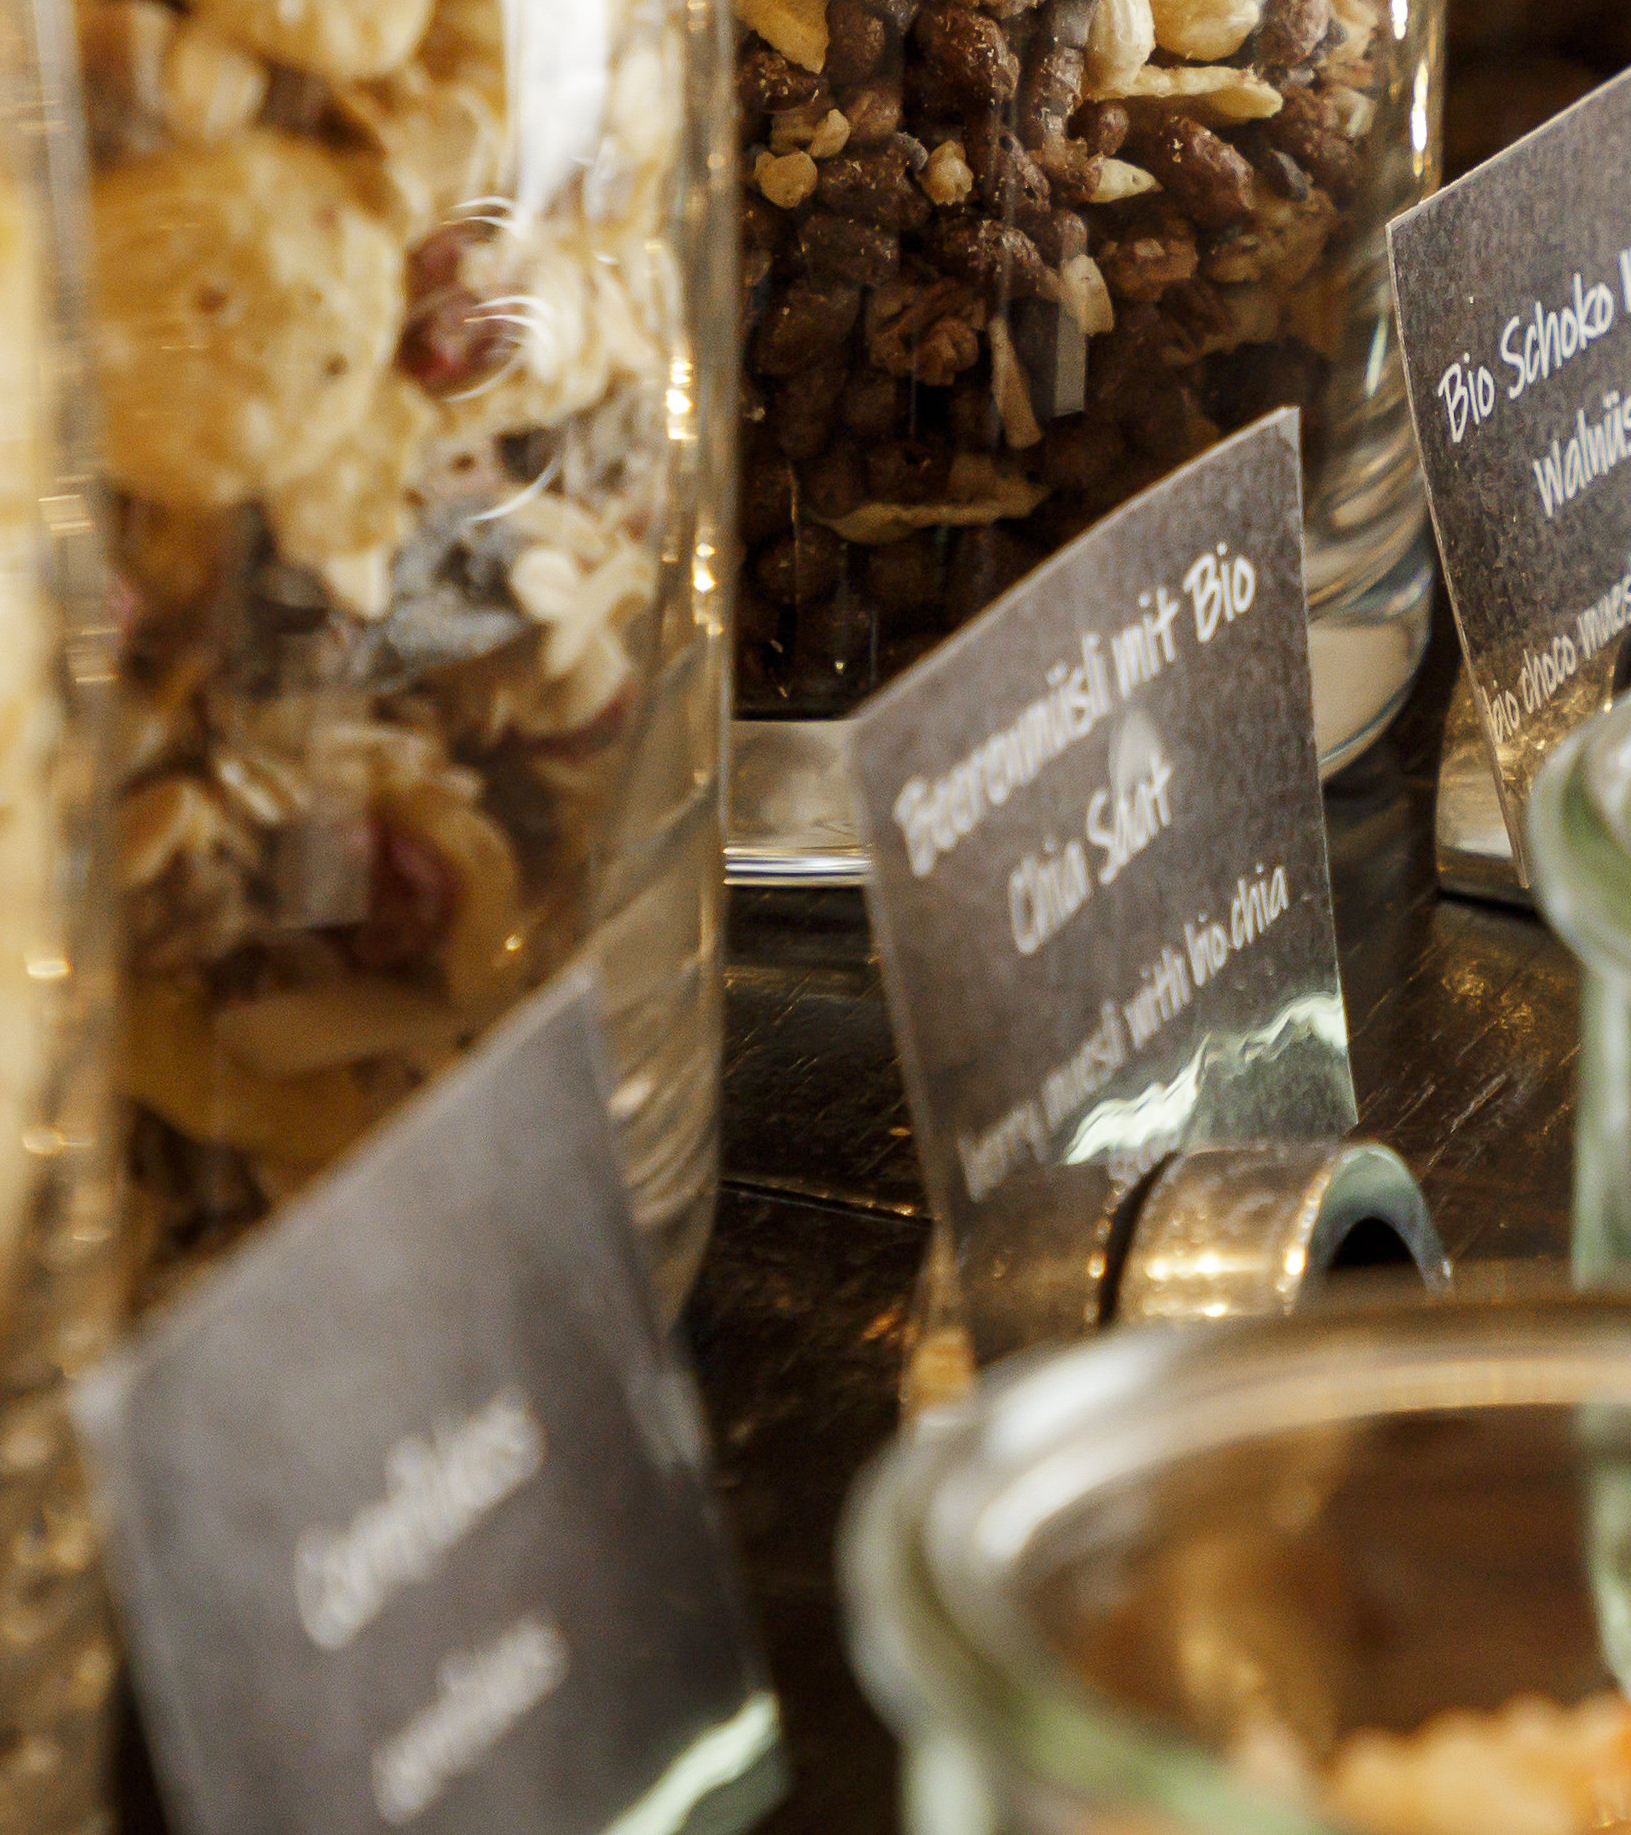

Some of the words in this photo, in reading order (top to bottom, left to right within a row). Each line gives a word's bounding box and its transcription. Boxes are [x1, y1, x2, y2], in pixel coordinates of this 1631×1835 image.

[1438, 353, 1494, 444] Bio
[1500, 272, 1613, 400] Schoko
[891, 632, 1112, 879] Beerenmüsli
[1109, 584, 1180, 699] mit
[1184, 541, 1257, 645] Bio
[1518, 634, 1577, 714] choco
[1007, 839, 1092, 956] Chia
[1086, 755, 1173, 886] Saat
[1123, 946, 1193, 1050] with
[1184, 911, 1228, 988] bio
[1231, 862, 1289, 950] chia
